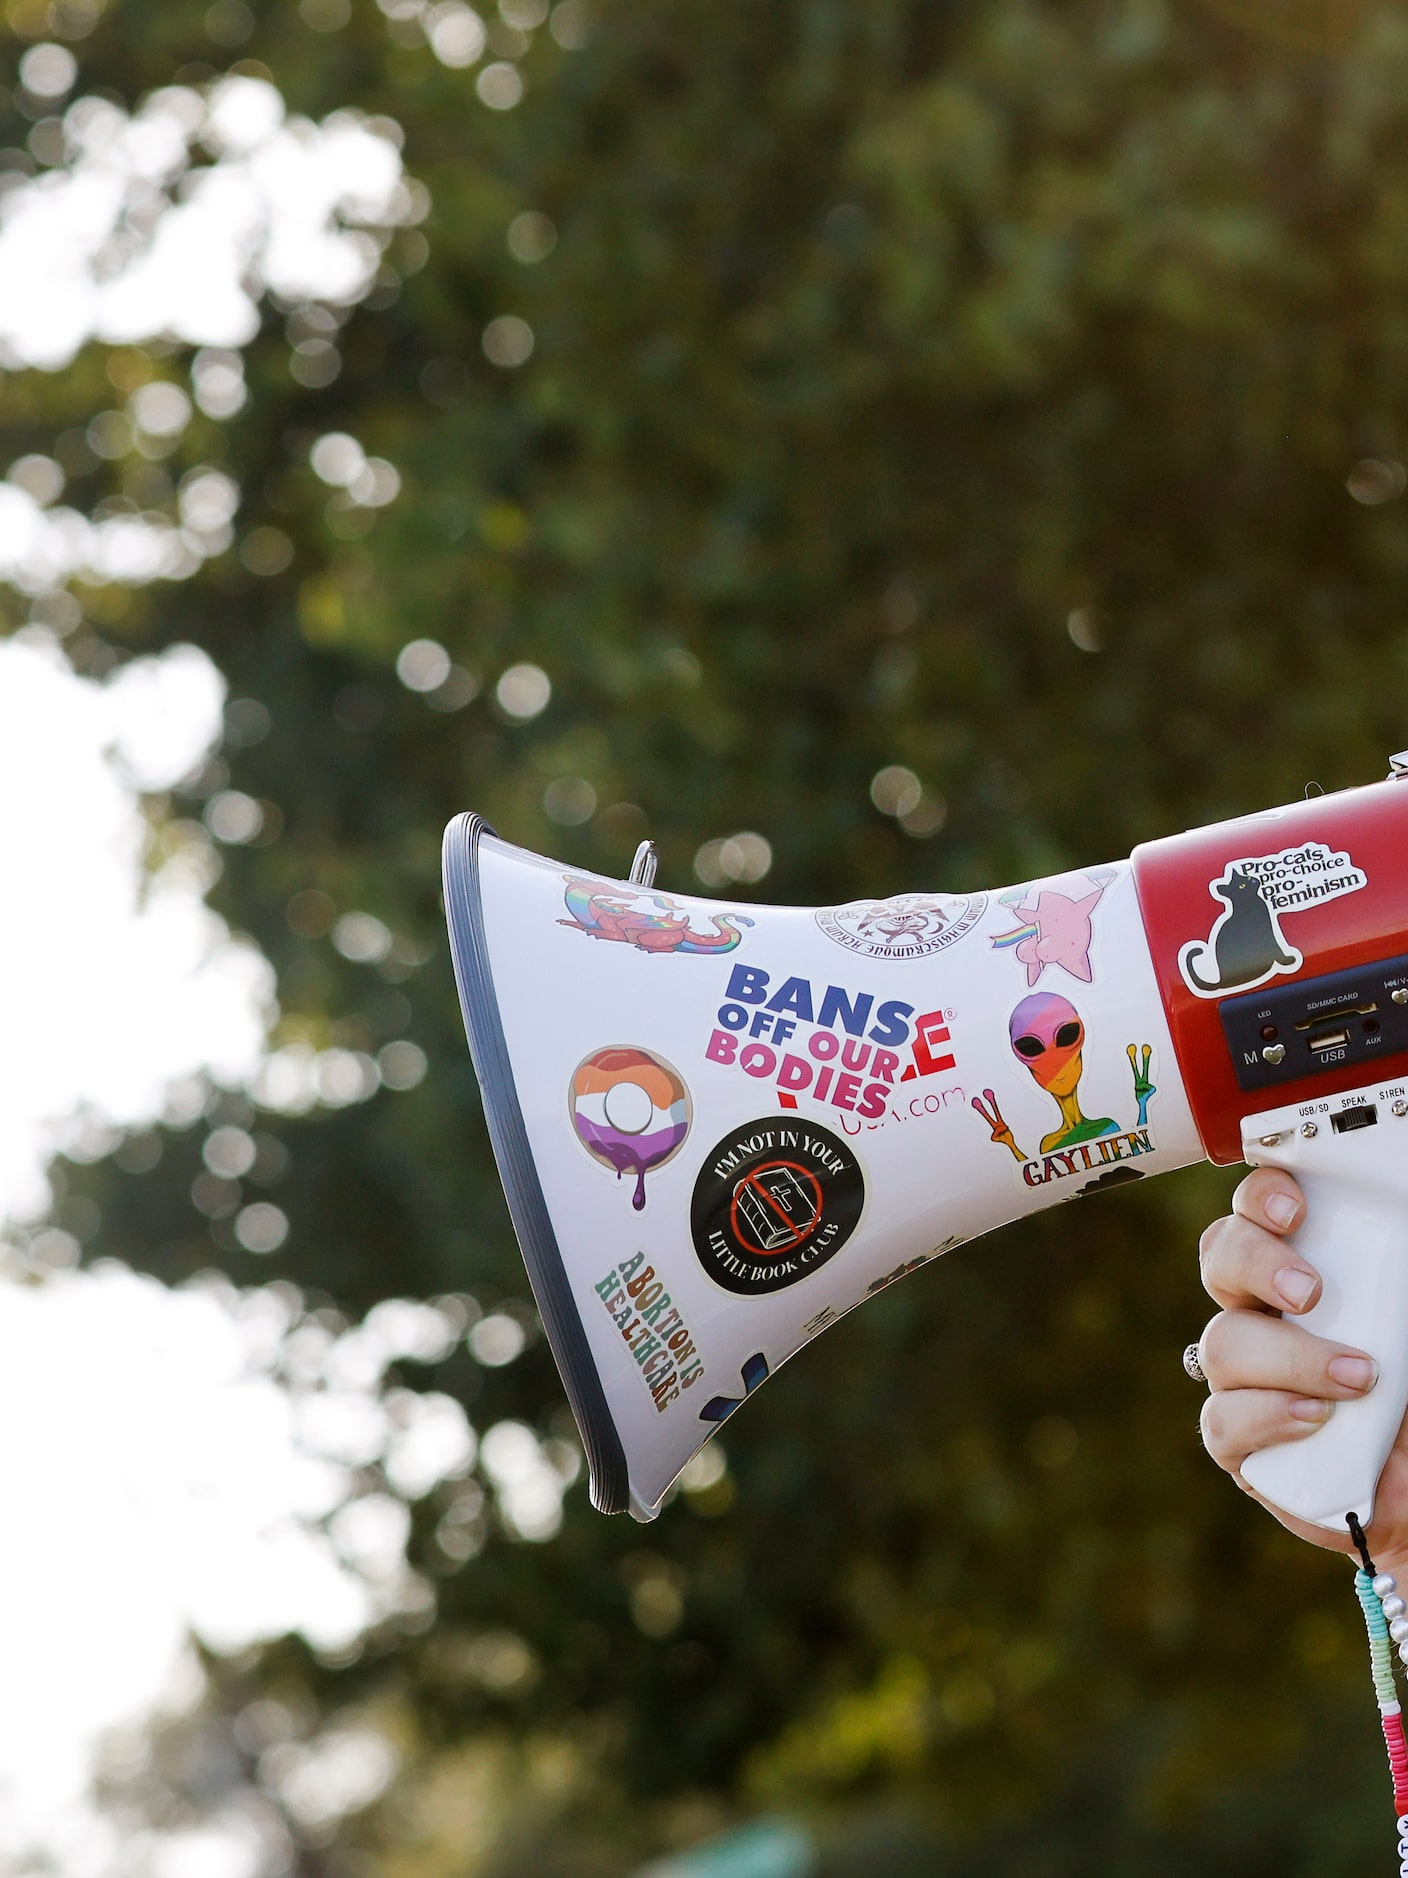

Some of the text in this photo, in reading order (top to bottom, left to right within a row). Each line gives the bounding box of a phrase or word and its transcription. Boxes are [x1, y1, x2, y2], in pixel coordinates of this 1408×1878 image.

[1240, 848, 1324, 876] Pro-cats
[1259, 857, 1344, 885] pro-choice
[1261, 879, 1303, 900] pro-
[1270, 873, 1360, 910] feminism
[724, 963, 915, 1047] BANS
[1257, 1009, 1272, 1019] LED
[1306, 992, 1359, 1011] SD/MMC CARD
[717, 1003, 797, 1047] OFF
[808, 1031, 900, 1084] OUR
[1243, 1050, 1259, 1065] M
[1320, 1050, 1346, 1064] USB
[1365, 1036, 1382, 1046] AUX
[705, 1028, 891, 1119] BODIES
[1298, 1087, 1405, 1117] USB/SD SPEAK SIREN
[714, 1130, 846, 1180] I'M NOT IN YOUR
[1022, 1129, 1156, 1187] GAYLIEN
[708, 1223, 839, 1281] LITTLE BOOK CLUB
[618, 1250, 705, 1389] ABORTION IS
[594, 1269, 680, 1413] HEALTHCARE
